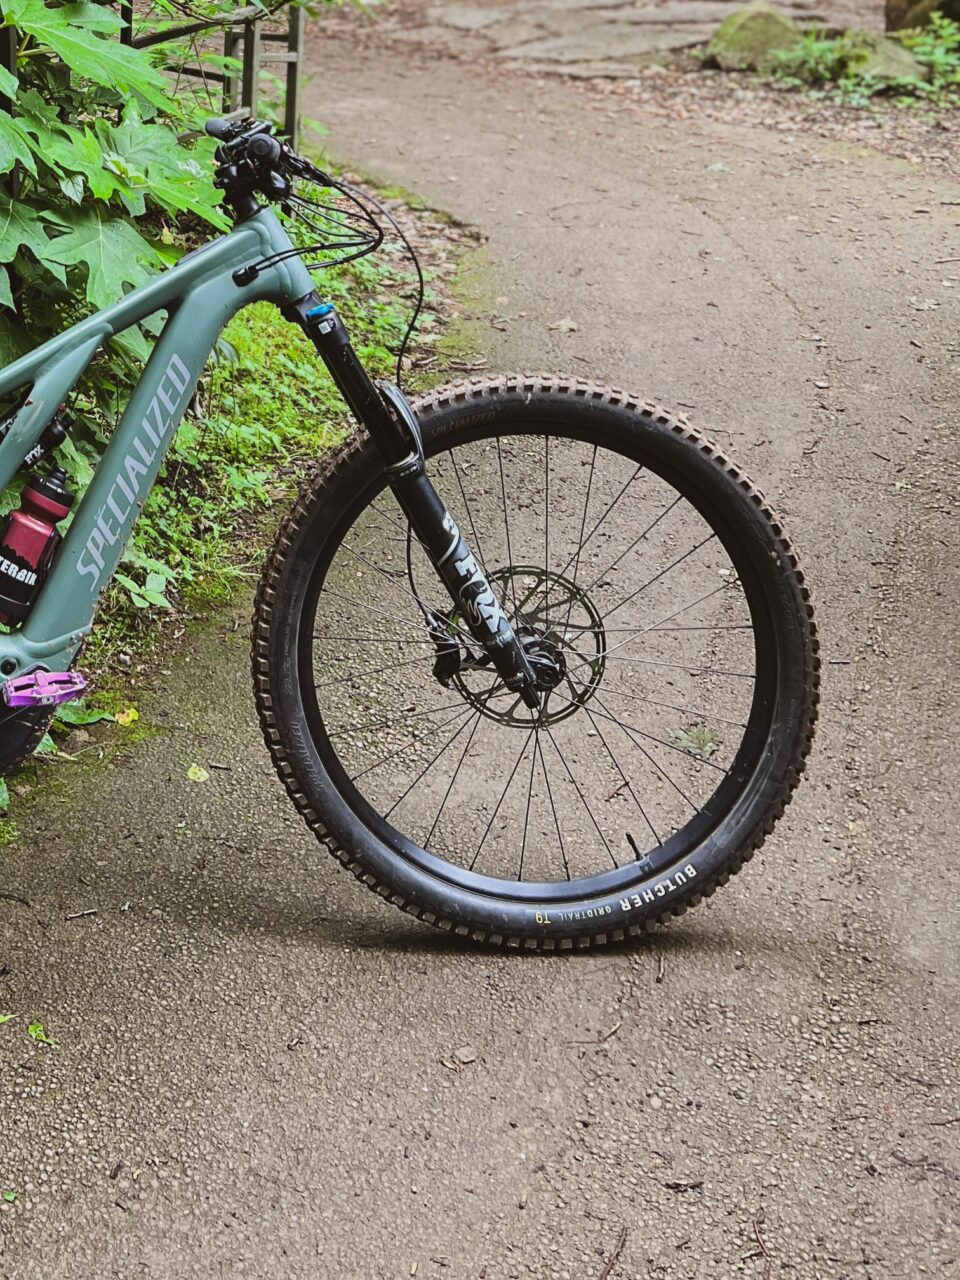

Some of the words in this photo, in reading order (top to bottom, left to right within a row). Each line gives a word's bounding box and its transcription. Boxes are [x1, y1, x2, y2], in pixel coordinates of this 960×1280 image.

[76, 353, 191, 592] SPECIALIZED
[453, 551, 508, 635] FOX
[535, 910, 551, 924] T9
[618, 863, 698, 912] BUTCHER
